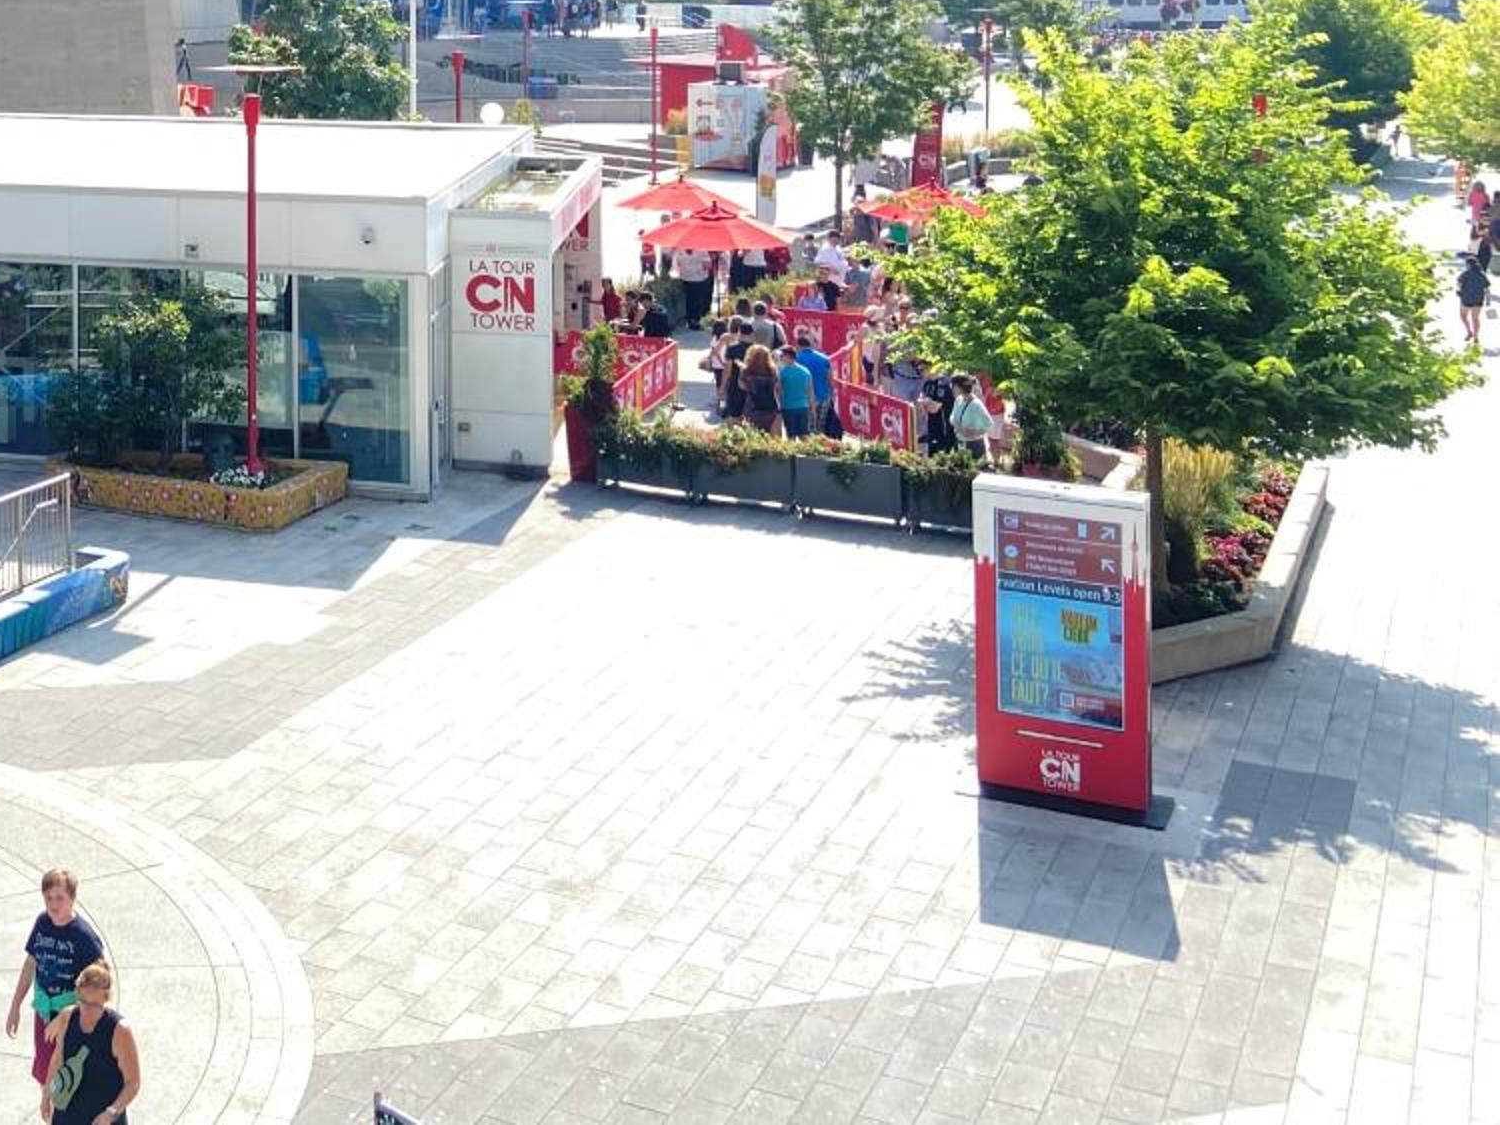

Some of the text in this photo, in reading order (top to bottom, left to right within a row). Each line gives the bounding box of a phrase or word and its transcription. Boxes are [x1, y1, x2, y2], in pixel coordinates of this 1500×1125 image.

[469, 260, 535, 275] LA TOUR
[466, 274, 535, 314] CN
[470, 313, 535, 332] TOWER
[1073, 587, 1101, 602] open
[1040, 757, 1081, 782] CN
[1043, 777, 1080, 792] TOWER
